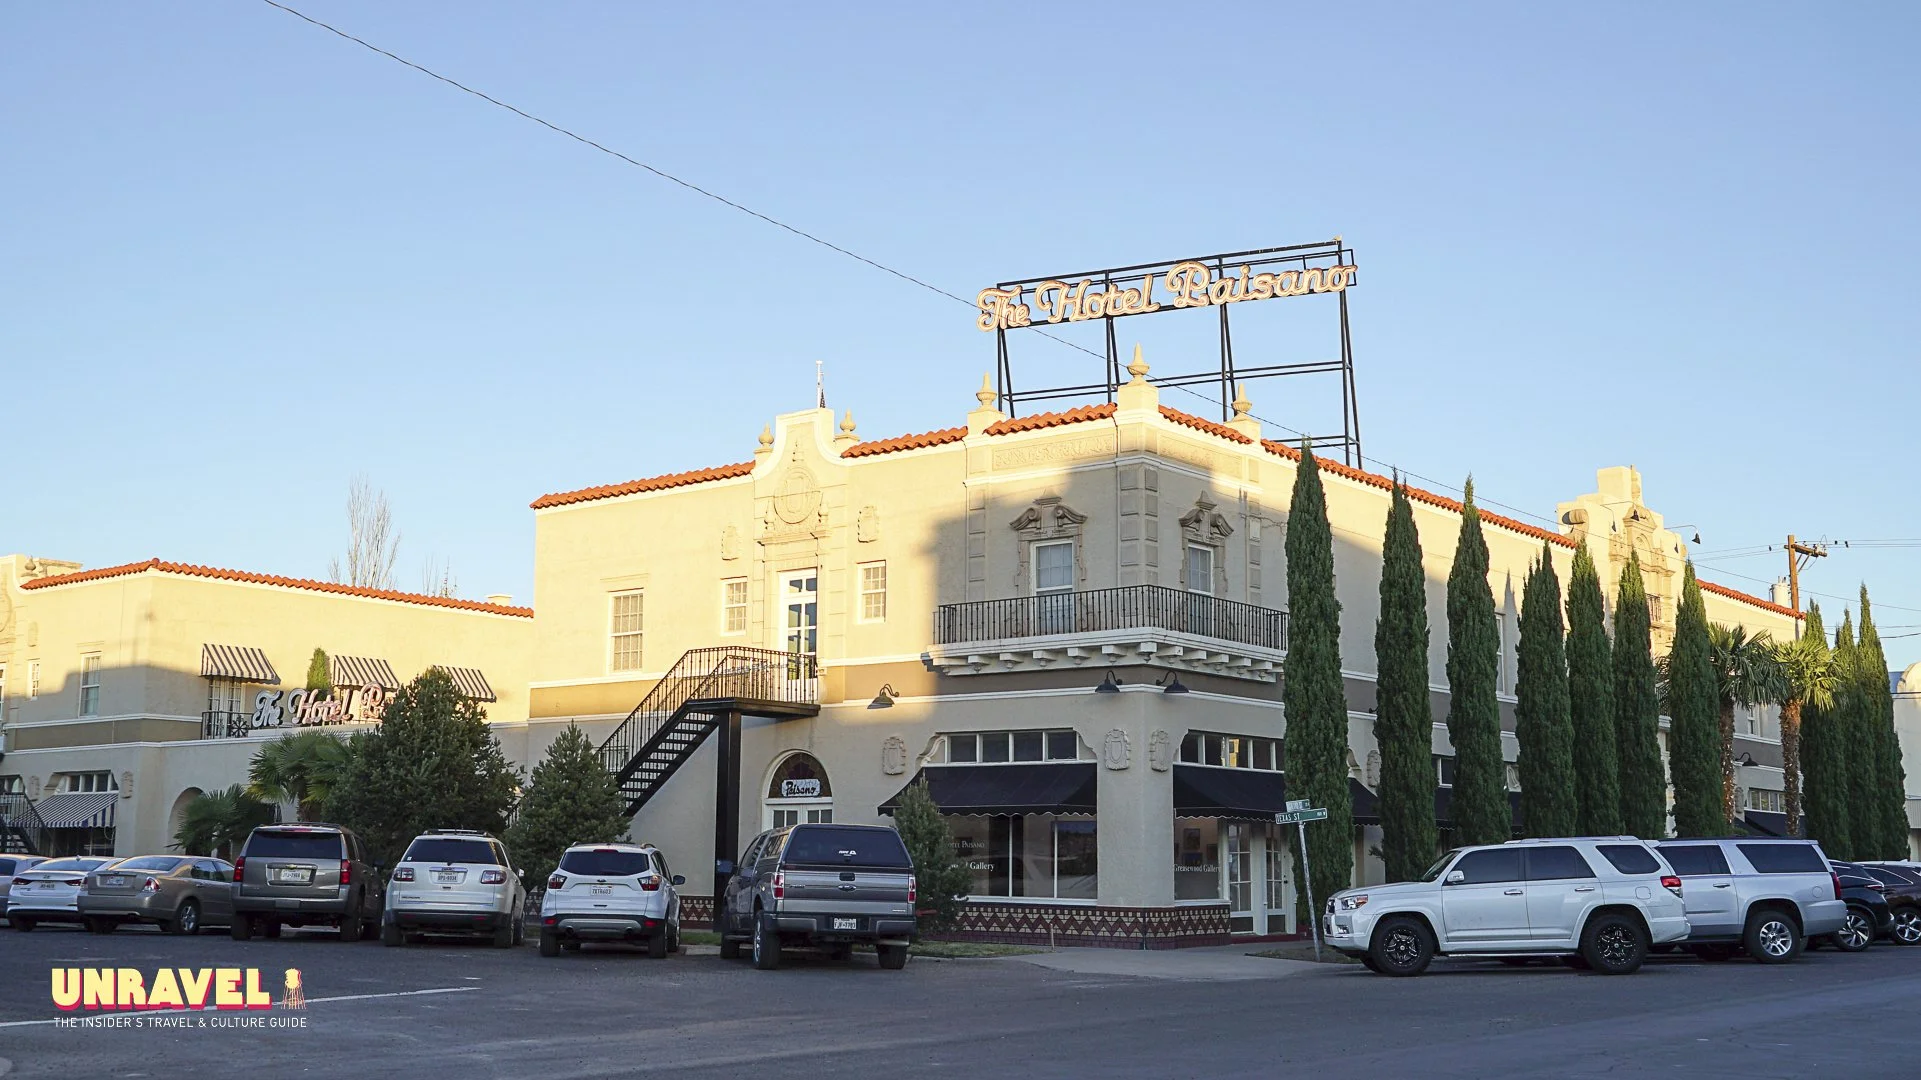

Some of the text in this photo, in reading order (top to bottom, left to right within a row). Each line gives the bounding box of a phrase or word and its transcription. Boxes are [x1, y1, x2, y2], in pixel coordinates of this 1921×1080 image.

[976, 261, 1358, 333] The Hotel Paisano
[252, 689, 283, 728] The
[288, 688, 353, 725] Hotel
[1293, 812, 1301, 821] ST
[969, 861, 995, 872] Gallery
